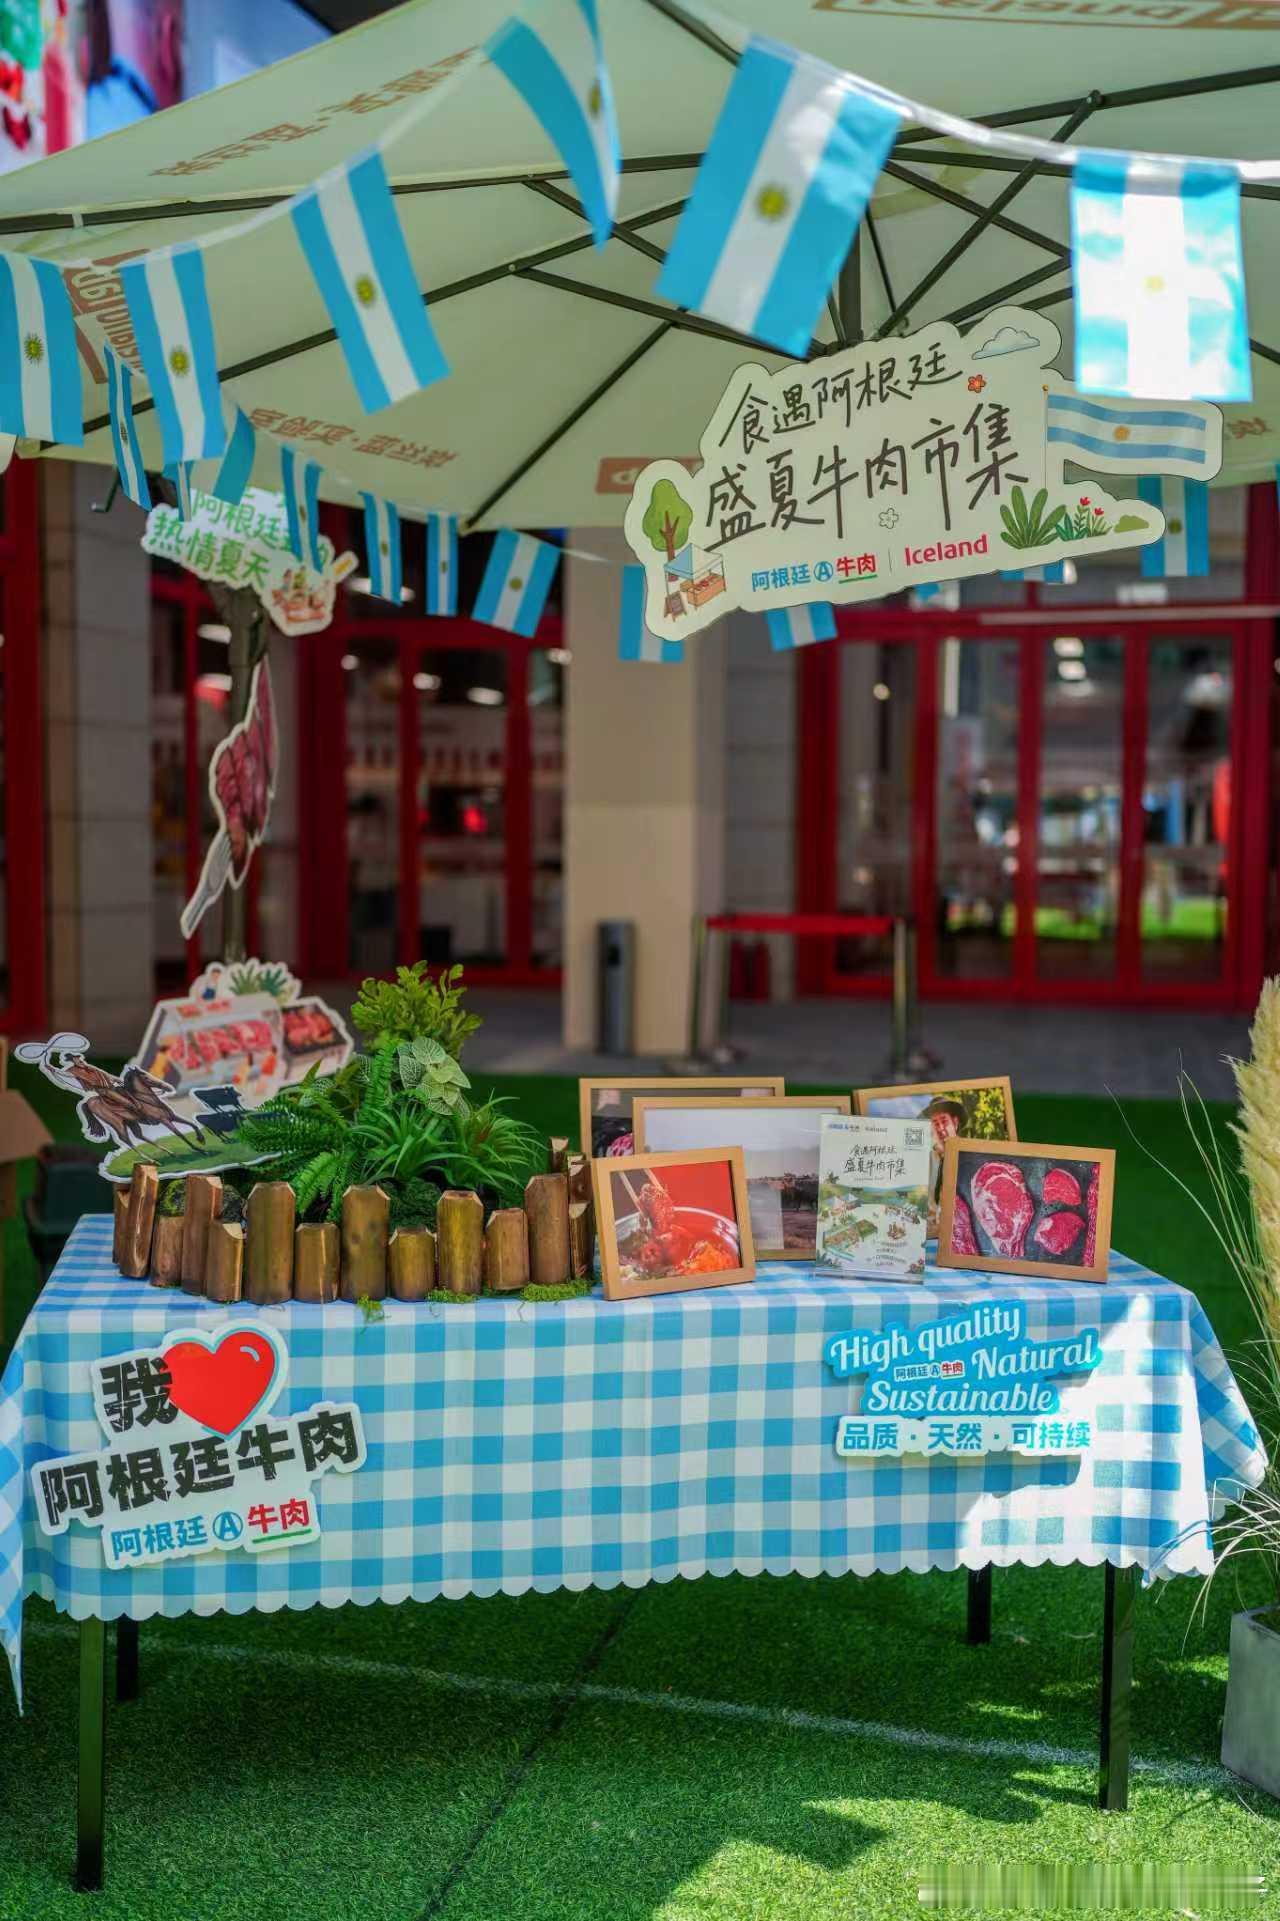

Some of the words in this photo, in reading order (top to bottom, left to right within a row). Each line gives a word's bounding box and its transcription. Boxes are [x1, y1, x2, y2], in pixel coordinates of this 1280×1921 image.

[719, 342, 963, 454] 食遇阿根廷
[704, 403, 1029, 551] 盛夏牛肉市集
[149, 510, 270, 587] 热情夏天
[752, 563, 811, 592] 阿根廷
[836, 553, 877, 577] 牛肉
[904, 534, 988, 566] Iceland
[830, 1329, 914, 1372] High
[918, 1306, 1020, 1360] quality
[971, 1335, 1097, 1380] Natural
[100, 1357, 178, 1432] 我
[867, 1381, 1053, 1412] Sustainable
[40, 1411, 358, 1527] 阿根廷牛肉
[110, 1515, 208, 1561] 阿根廷
[248, 1498, 310, 1534] 牛肉
